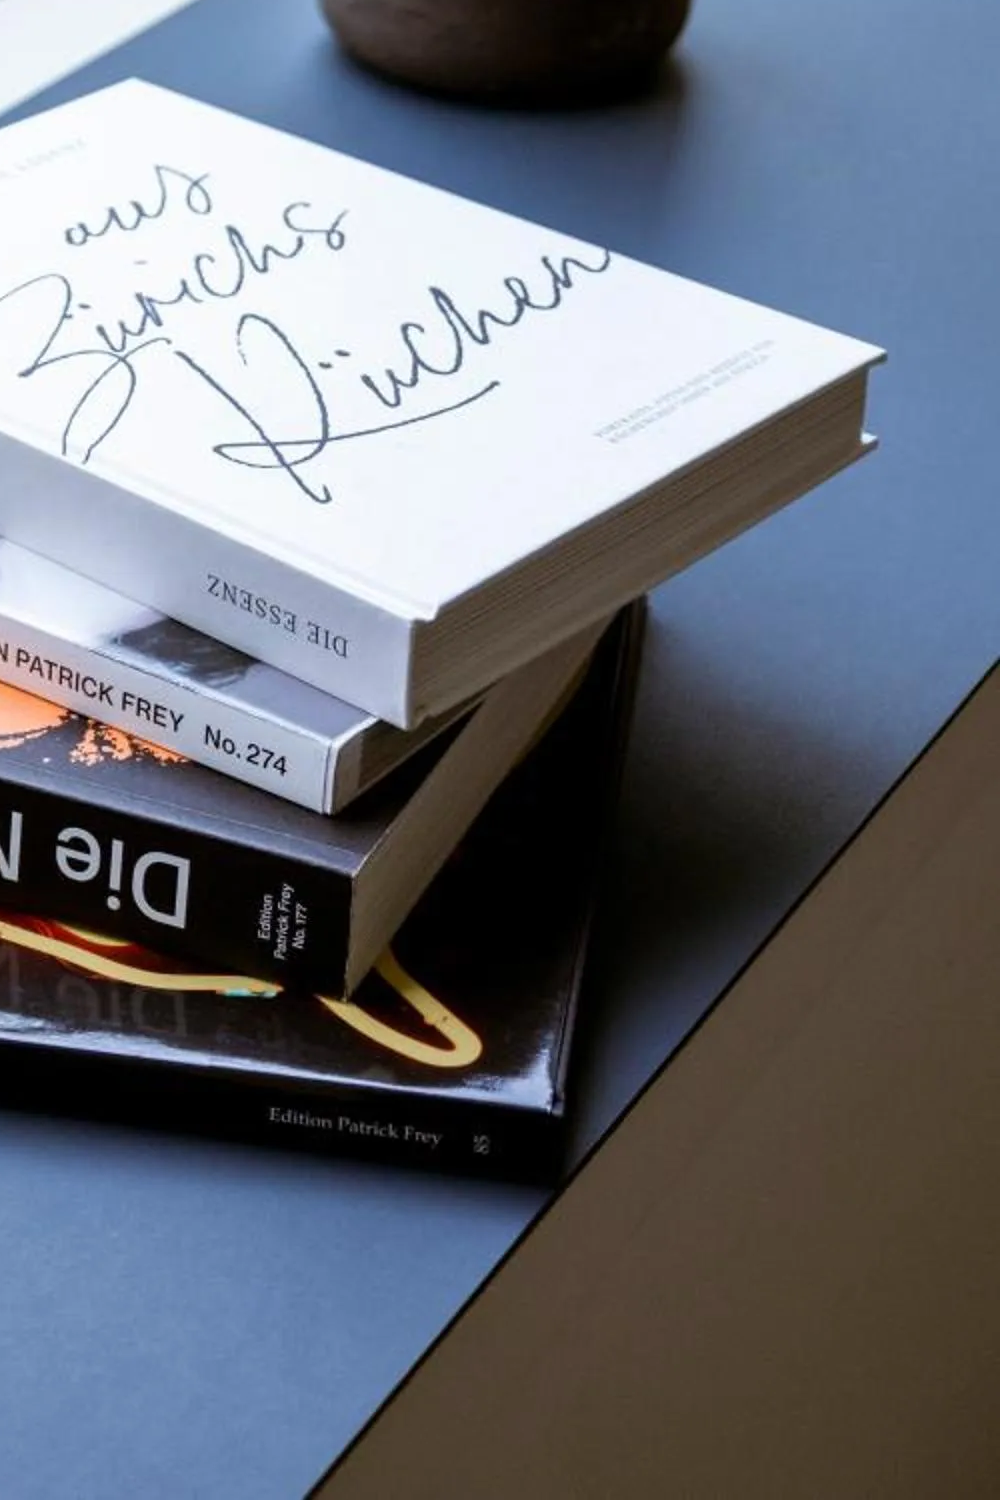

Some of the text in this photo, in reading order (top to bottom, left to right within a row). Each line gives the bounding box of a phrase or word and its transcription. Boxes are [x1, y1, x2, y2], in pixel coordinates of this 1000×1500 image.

[66, 165, 210, 246] aus
[206, 573, 350, 659] DIE ESSENZ
[16, 648, 114, 707] PATRICK
[121, 690, 185, 733] FREY
[205, 723, 242, 760] No.
[246, 743, 288, 777] 274
[55, 826, 191, 930] Die
[257, 893, 274, 941] Edition
[273, 882, 296, 960] Patrick Frey
[268, 1106, 443, 1150] Edition Patrick Frey
